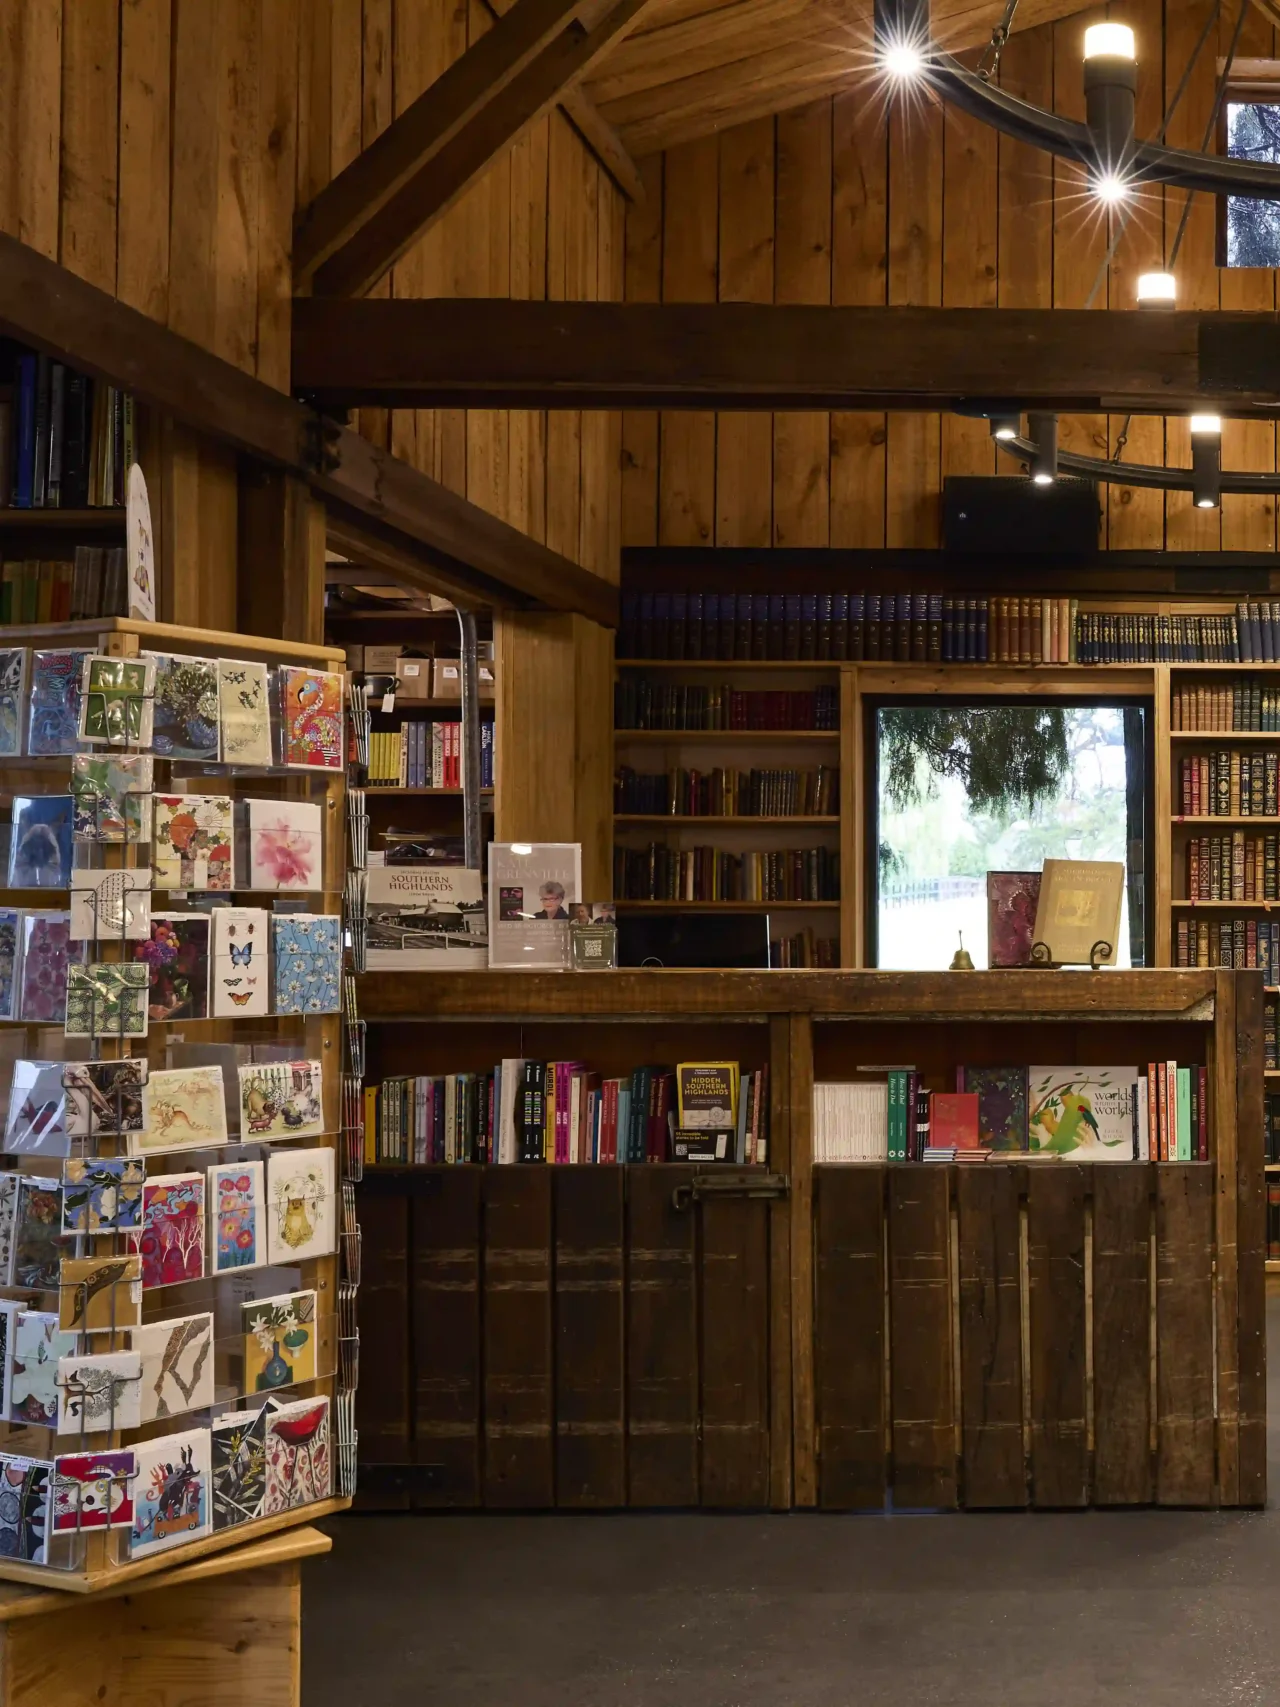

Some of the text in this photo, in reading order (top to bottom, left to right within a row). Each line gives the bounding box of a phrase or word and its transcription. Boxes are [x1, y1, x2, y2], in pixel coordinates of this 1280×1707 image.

[391, 875, 449, 884] SOUTHERN
[496, 869, 570, 880] GRENVILLE
[389, 882, 453, 892] HIGHLANDS
[1200, 1078, 1205, 1086] MY
[1095, 1087, 1133, 1101] worlds
[1095, 1101, 1133, 1115] worlds
